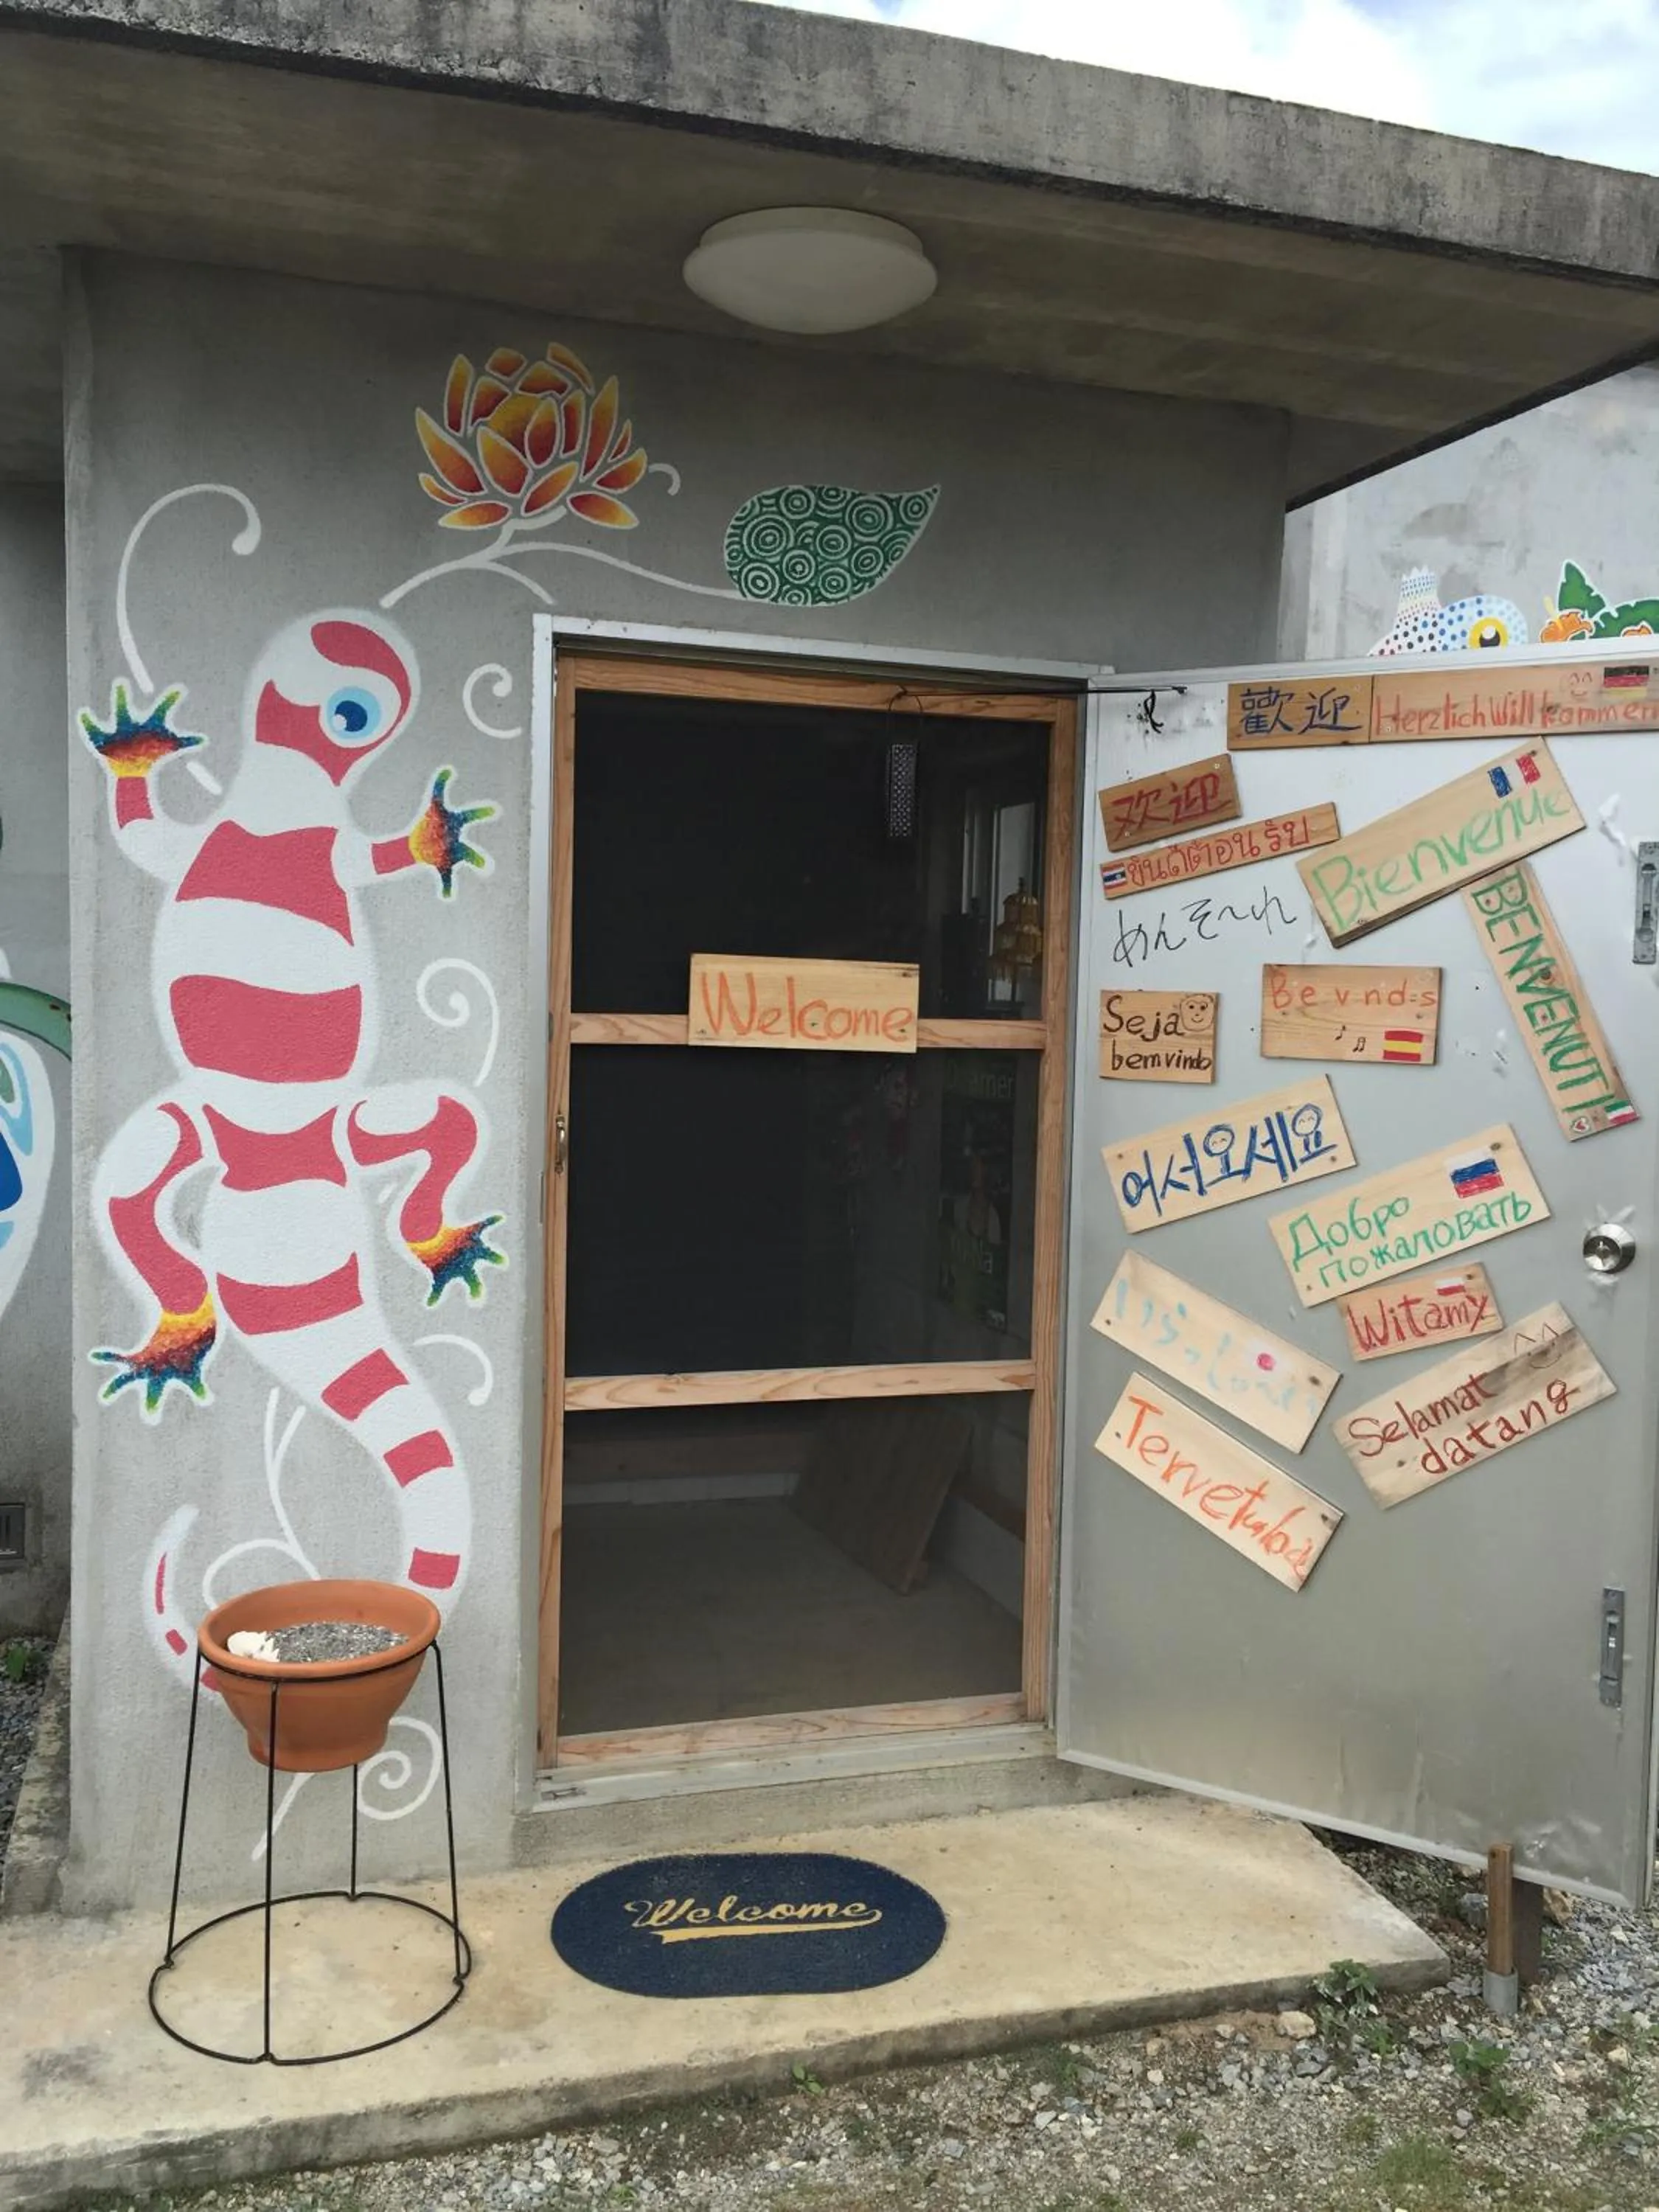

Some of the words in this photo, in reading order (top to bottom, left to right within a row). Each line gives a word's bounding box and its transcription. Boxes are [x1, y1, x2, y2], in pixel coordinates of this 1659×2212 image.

[1110, 772, 1233, 841] 欢迎
[1311, 788, 1572, 932] Bienvenue
[700, 970, 914, 1043] Welcome
[1102, 994, 1186, 1042] Seja
[1472, 867, 1615, 1113] BENVENUTI
[1288, 1196, 1410, 1273] Добро
[1346, 1293, 1488, 1352] Witamy
[1348, 1371, 1498, 1458] Selamat
[1421, 1378, 1582, 1474] datang
[624, 1894, 883, 1930] Welcome
